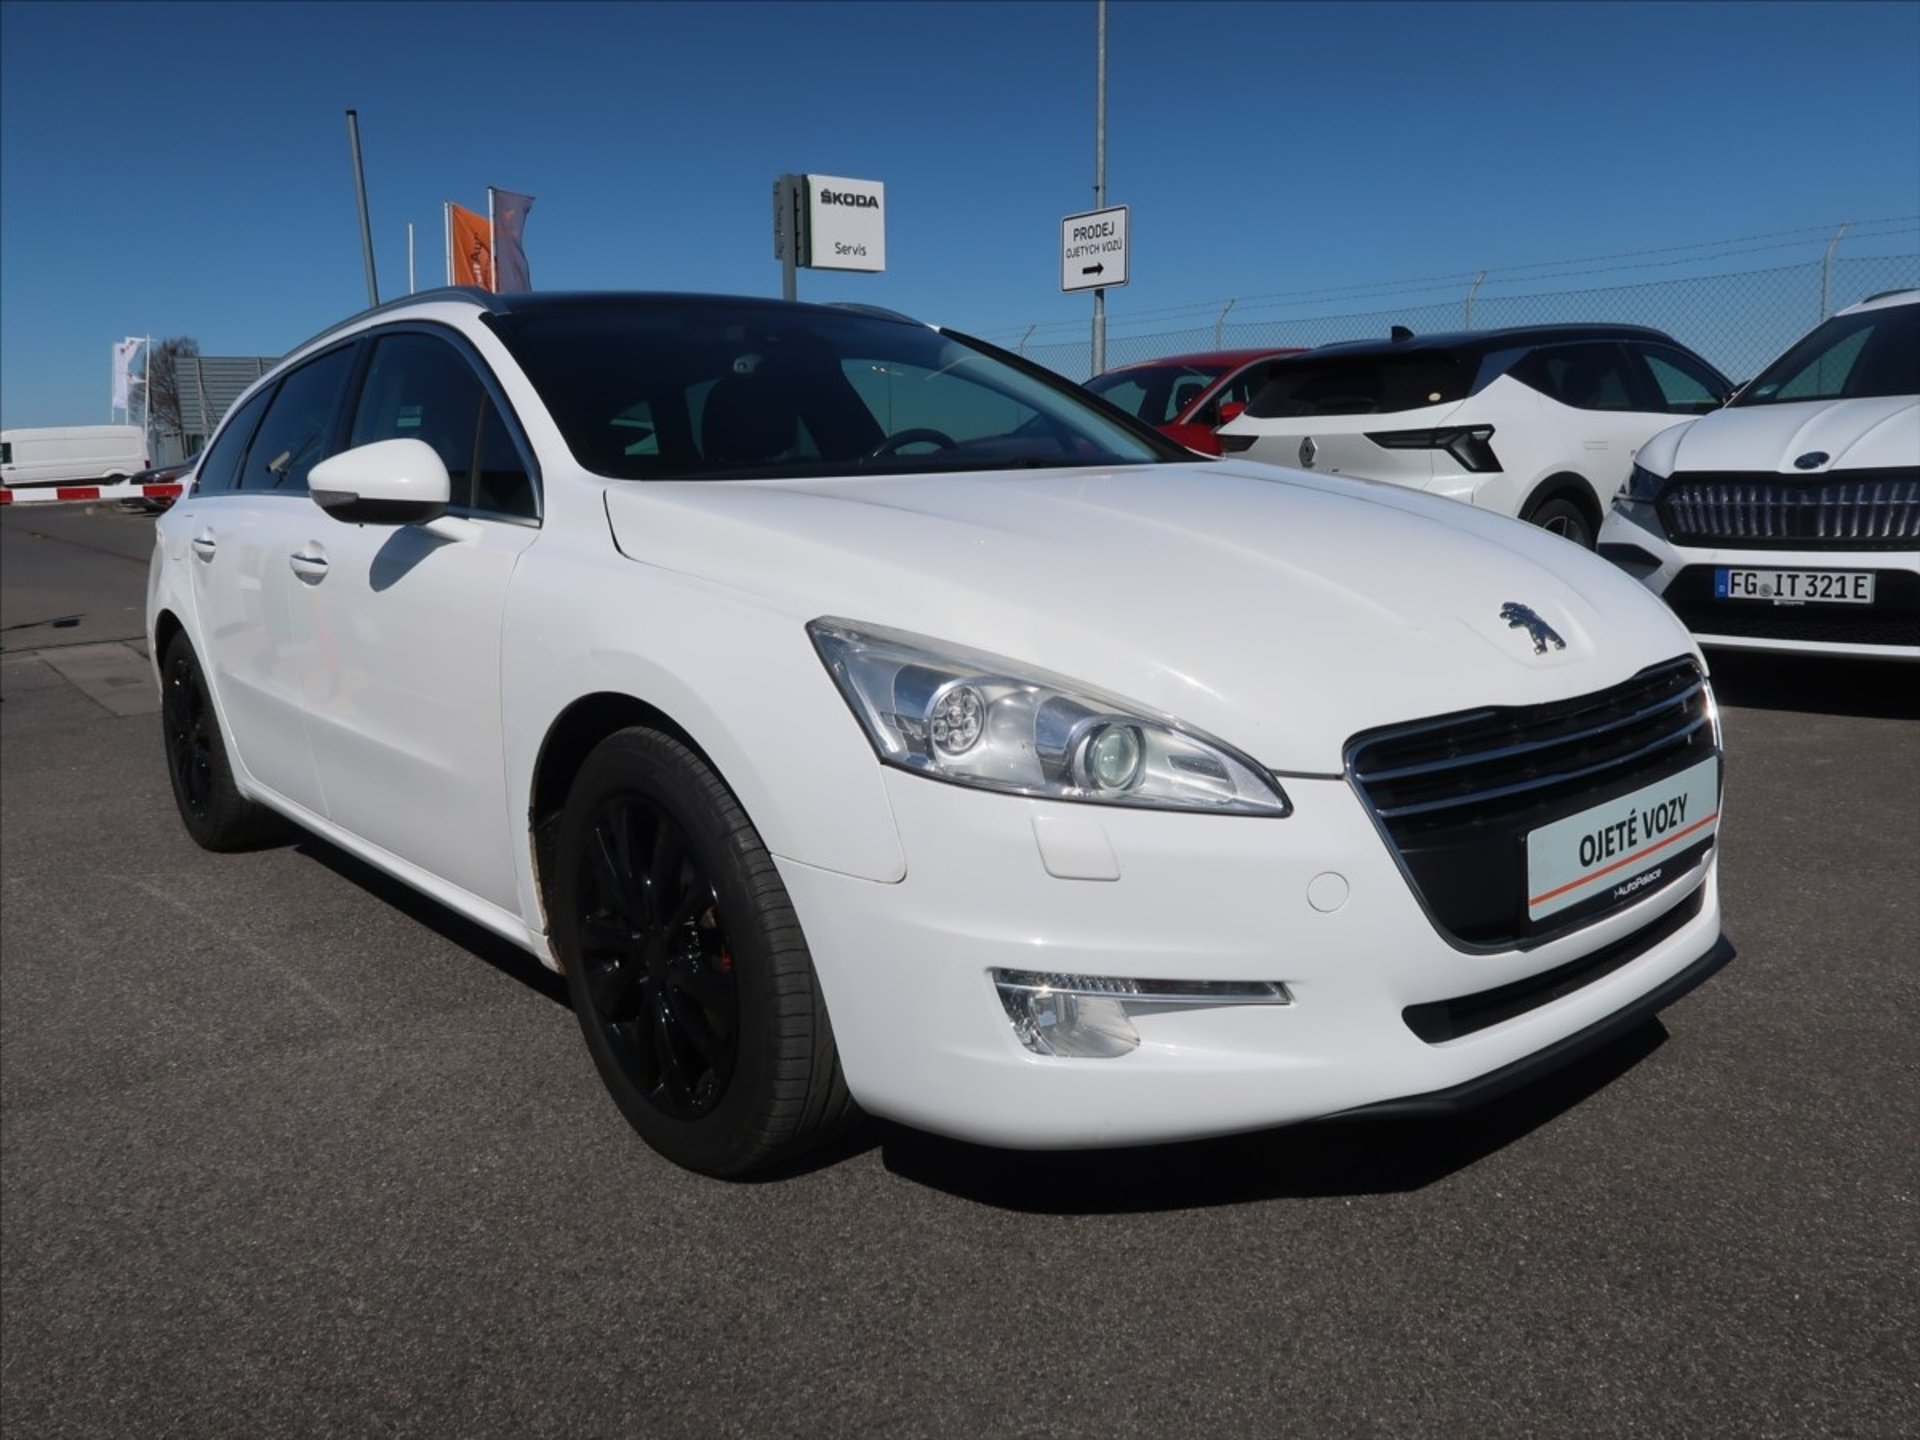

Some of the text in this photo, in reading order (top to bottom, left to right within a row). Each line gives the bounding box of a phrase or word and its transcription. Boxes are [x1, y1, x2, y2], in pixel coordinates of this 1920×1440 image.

[820, 188, 879, 209] ŠKODA
[1073, 221, 1115, 242] PRODEJ
[835, 241, 867, 256] Servis
[1730, 572, 1758, 595] FG
[1578, 793, 1688, 867] OJETÉ VOZY
